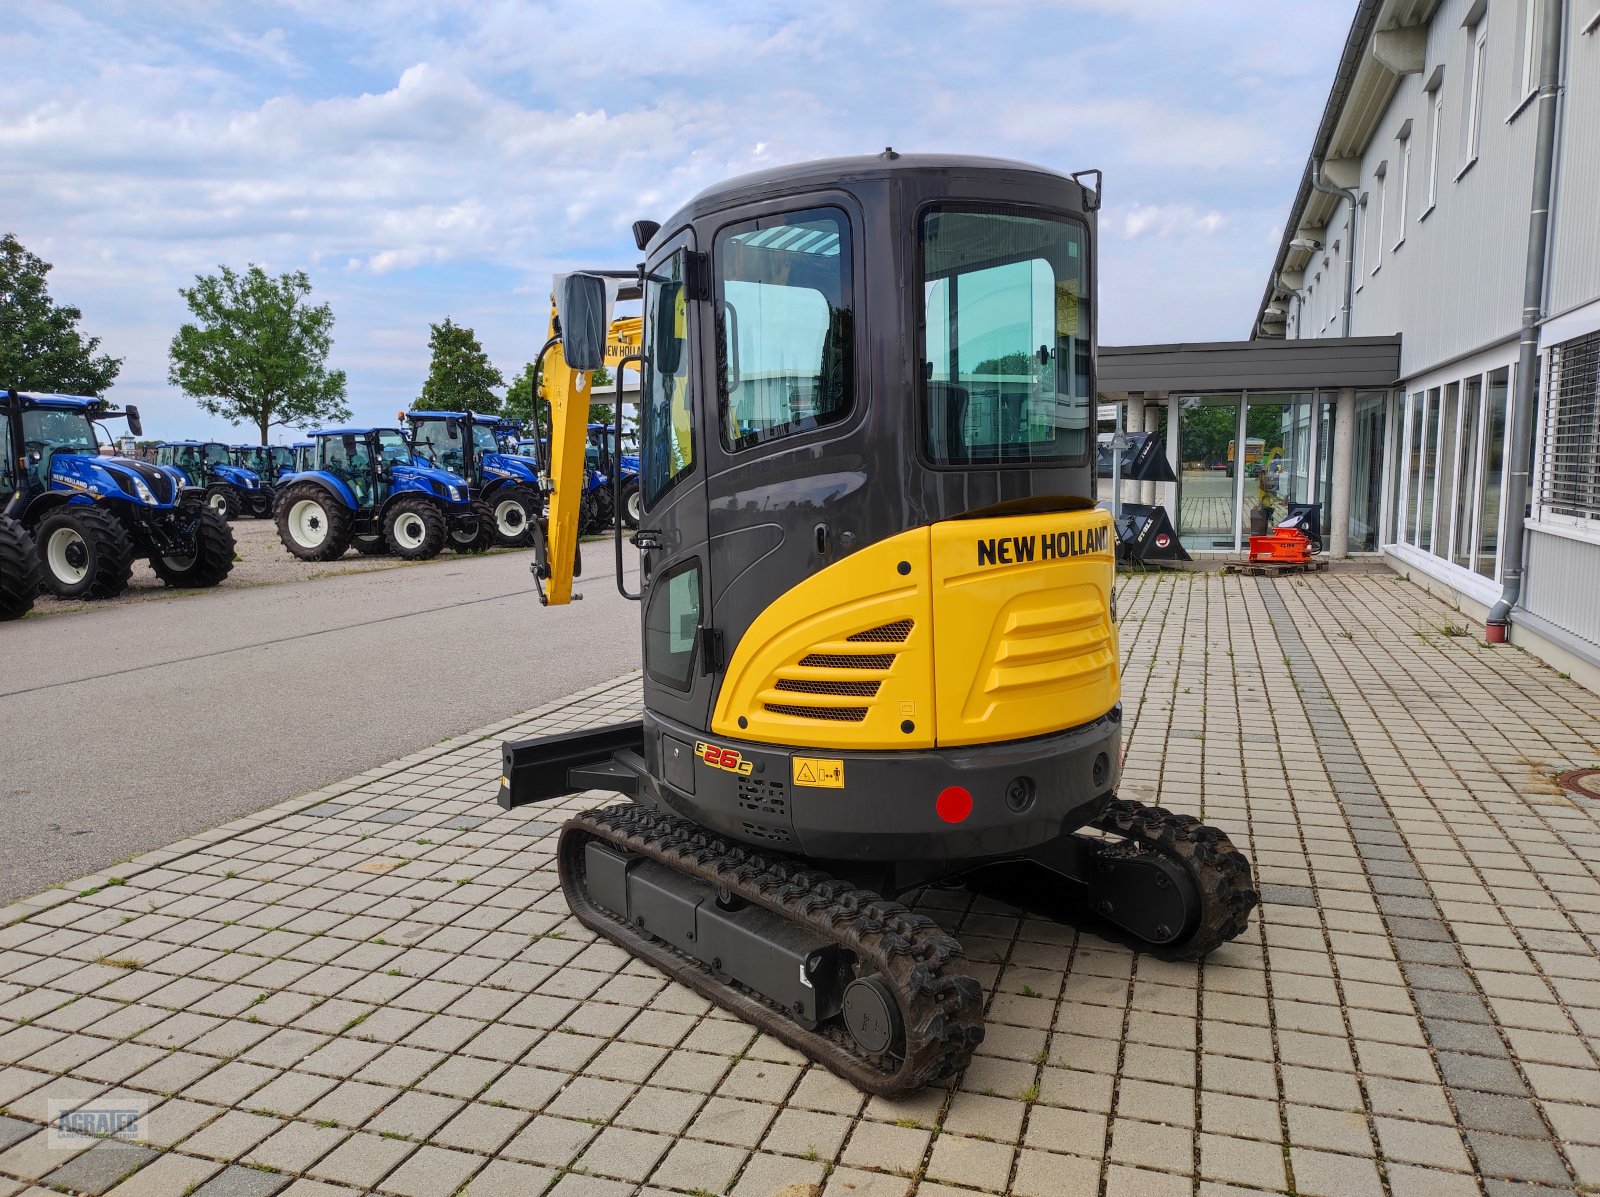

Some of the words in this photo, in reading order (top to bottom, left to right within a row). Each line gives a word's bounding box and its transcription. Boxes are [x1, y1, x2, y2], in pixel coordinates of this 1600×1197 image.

[53, 474, 64, 482] NEW
[64, 477, 88, 488] HOLLAND
[977, 535, 1036, 567] NEW
[1041, 525, 1109, 560] HOLLAND
